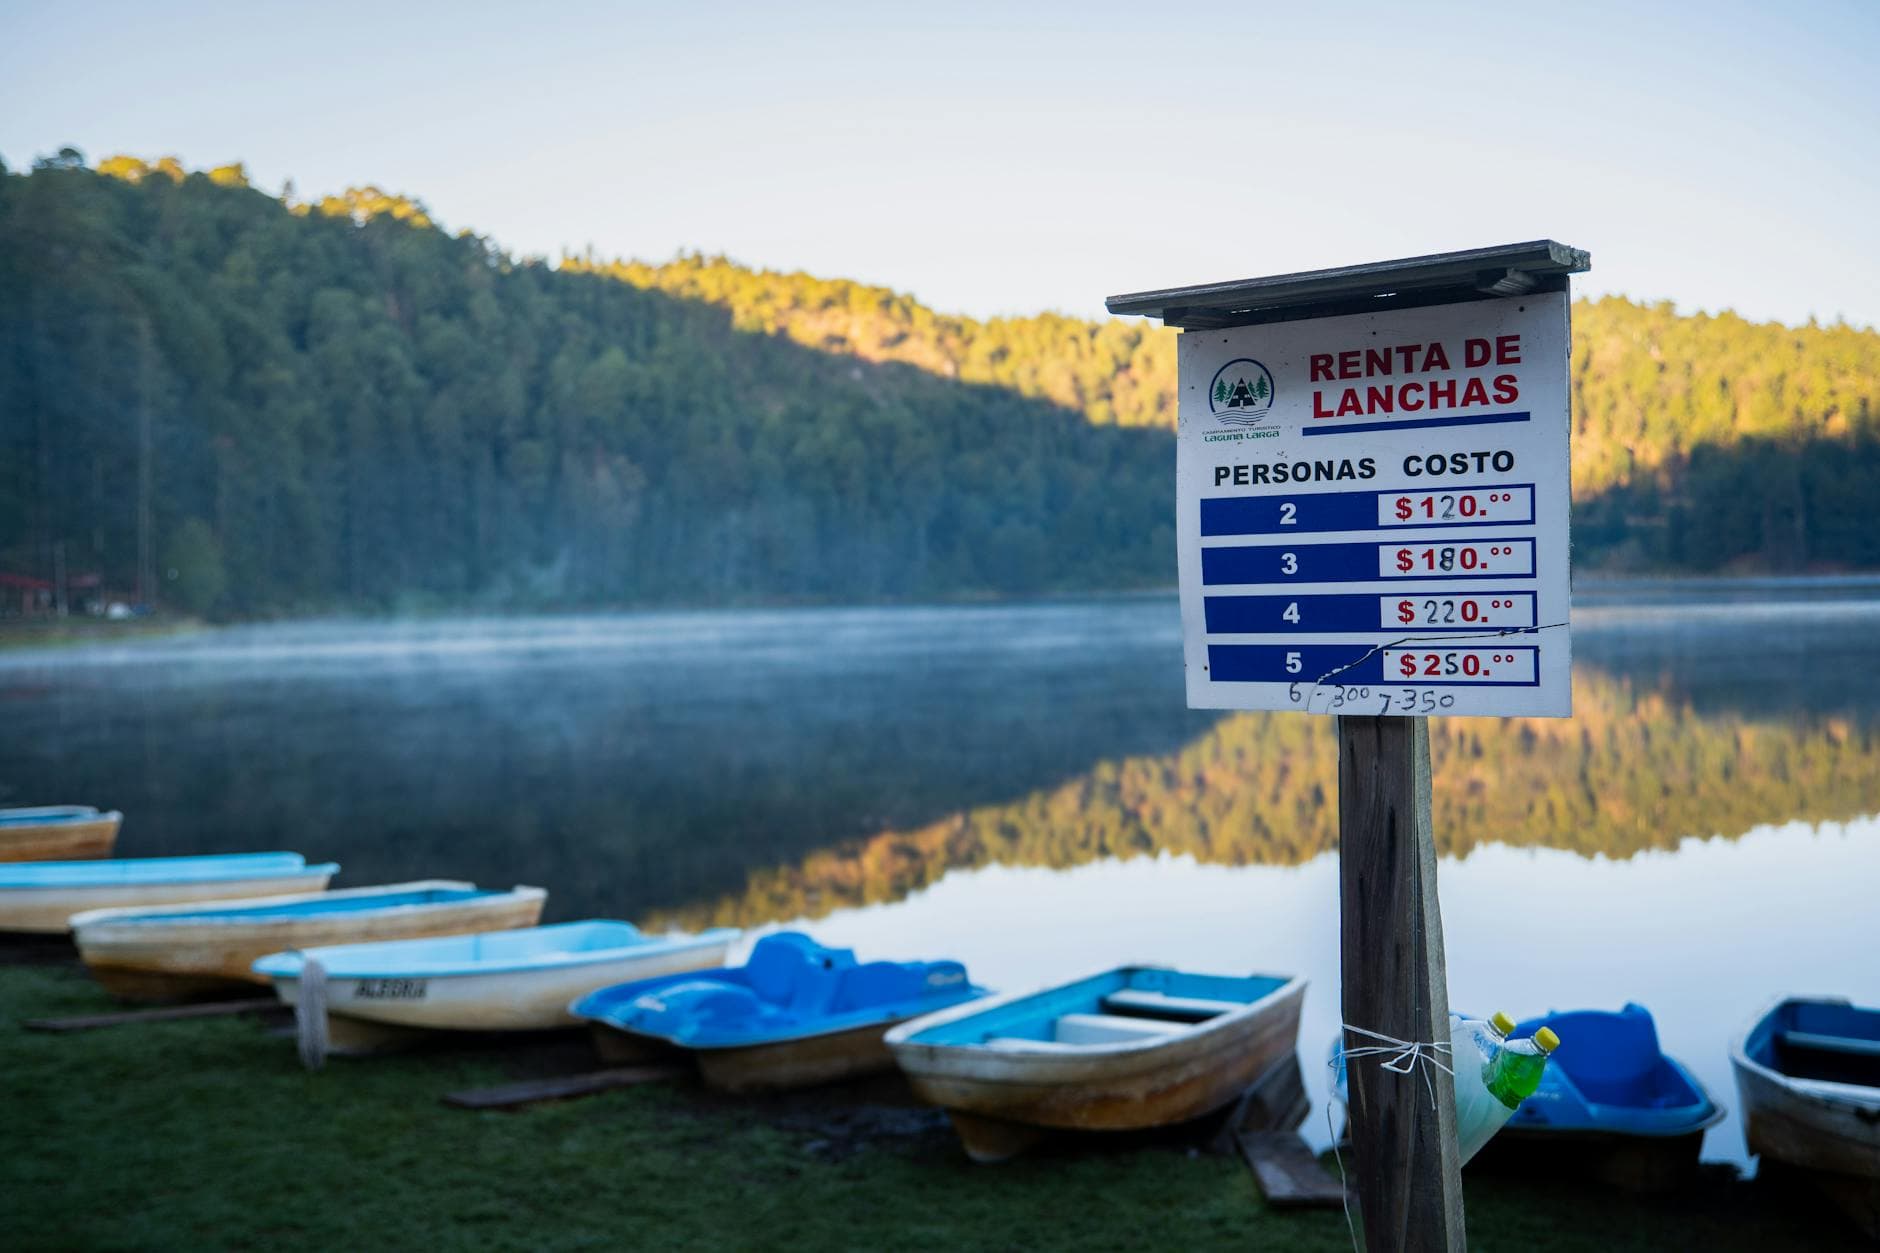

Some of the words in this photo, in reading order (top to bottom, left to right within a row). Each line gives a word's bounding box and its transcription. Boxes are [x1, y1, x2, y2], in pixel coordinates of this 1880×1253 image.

[1310, 341, 1450, 382] RENTA
[1464, 334, 1521, 368] DE
[1312, 374, 1519, 419] LANCHAS
[1214, 457, 1377, 487] PERSONAS
[1403, 450, 1515, 477] COSTO
[1279, 503, 1297, 525] 2
[1281, 552, 1299, 575] 3
[1282, 602, 1300, 624] 4
[1286, 652, 1302, 674] 5
